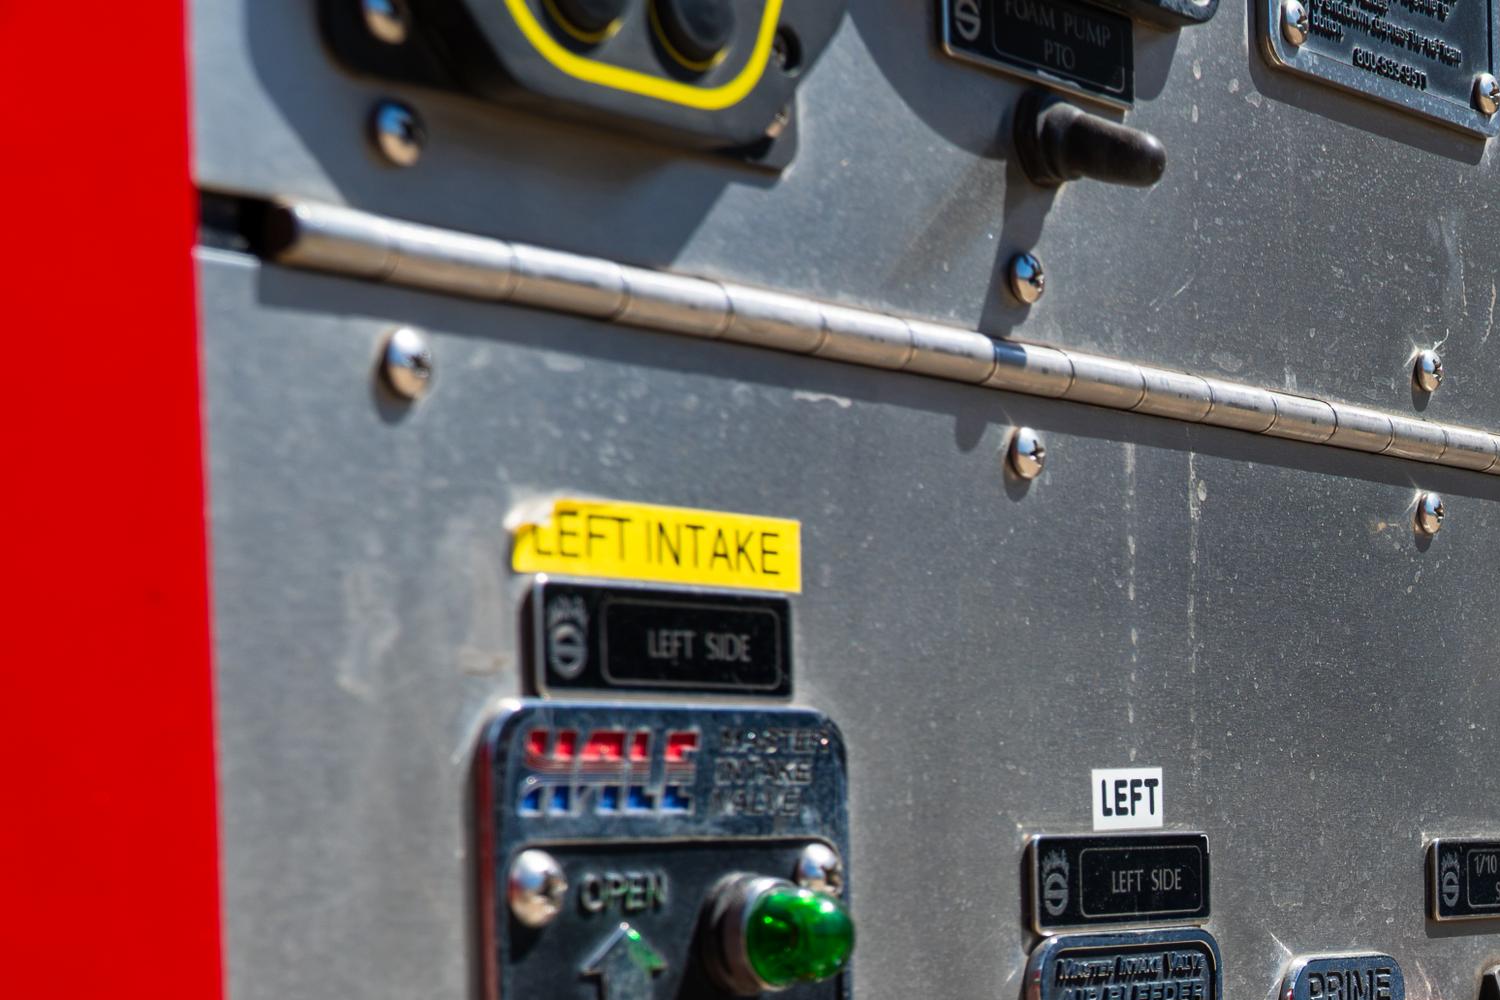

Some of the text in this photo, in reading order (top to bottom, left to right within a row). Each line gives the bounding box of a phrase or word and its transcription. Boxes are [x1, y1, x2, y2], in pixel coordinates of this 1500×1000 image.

[1063, 13, 1111, 48] PUMP
[1044, 39, 1076, 69] PTO
[532, 510, 781, 577] LEFT INTAKE
[647, 628, 752, 663] LEFT SIDE
[719, 725, 832, 756] MASTER
[713, 755, 813, 786] INTAKE
[711, 785, 803, 818] VALVE
[1101, 778, 1159, 817] LEFT
[1111, 868, 1182, 894] LEFT SIDE
[1474, 854, 1498, 877] 1/10
[580, 870, 669, 913] OPEN
